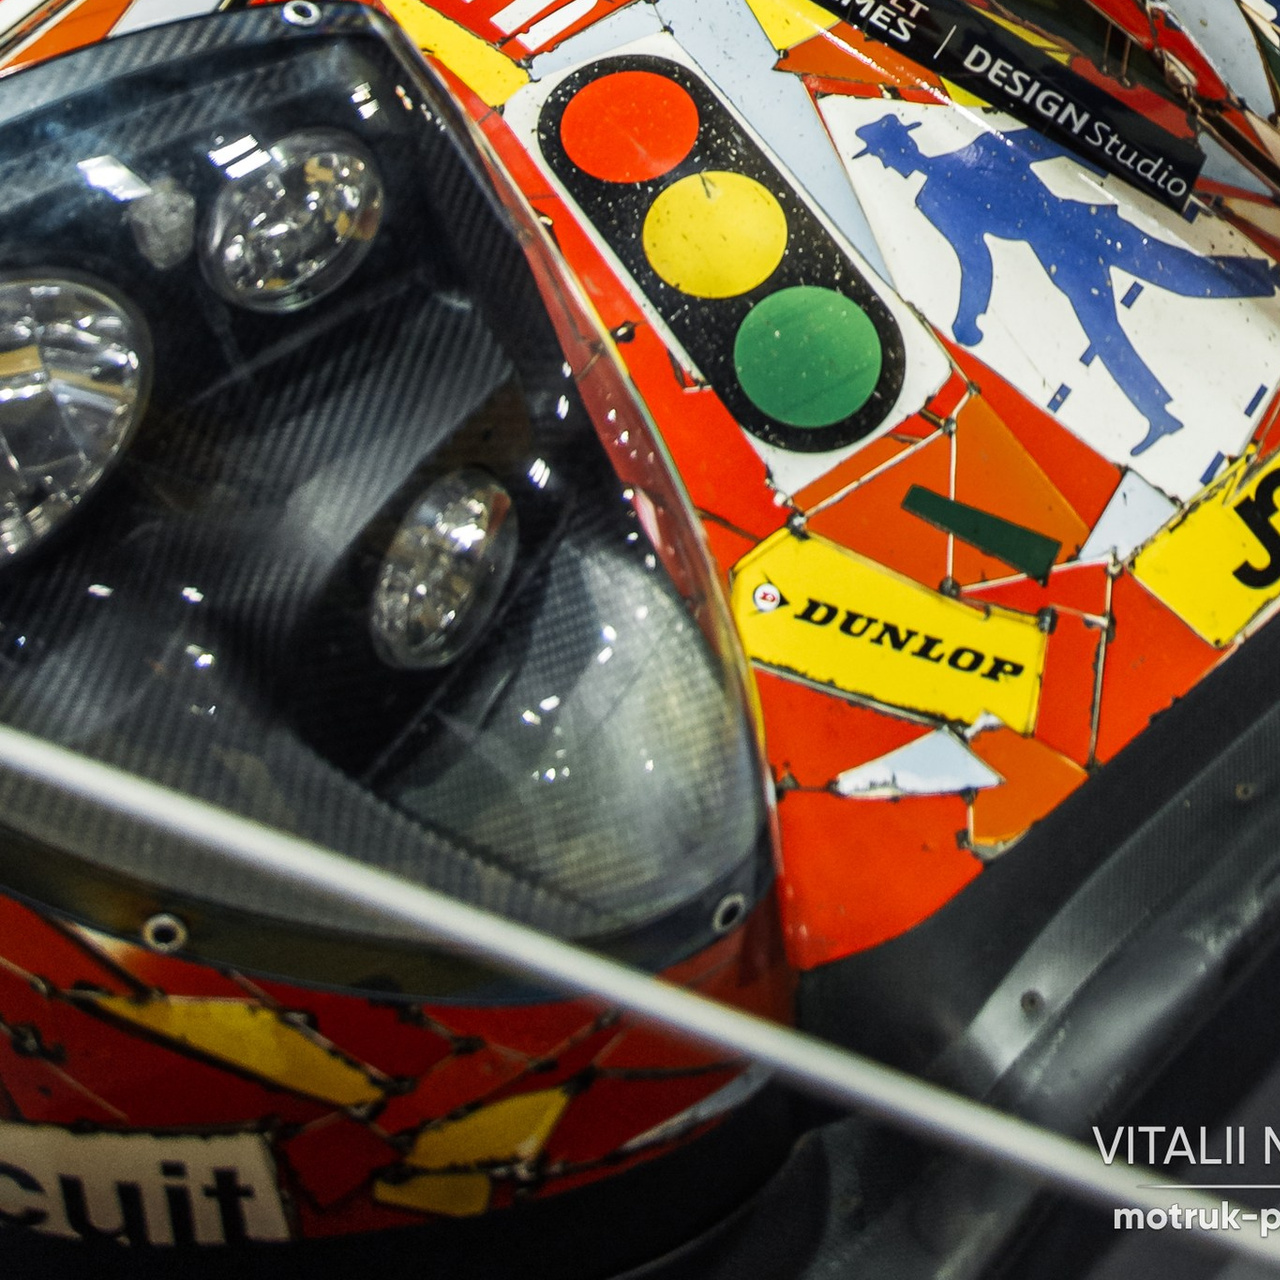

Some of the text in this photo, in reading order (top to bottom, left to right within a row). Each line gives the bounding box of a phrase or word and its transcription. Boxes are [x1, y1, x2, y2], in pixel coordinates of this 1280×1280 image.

[963, 43, 1188, 198] DESIGN Studio
[793, 594, 1025, 684] DUNLOP
[0, 1159, 254, 1244] cuit
